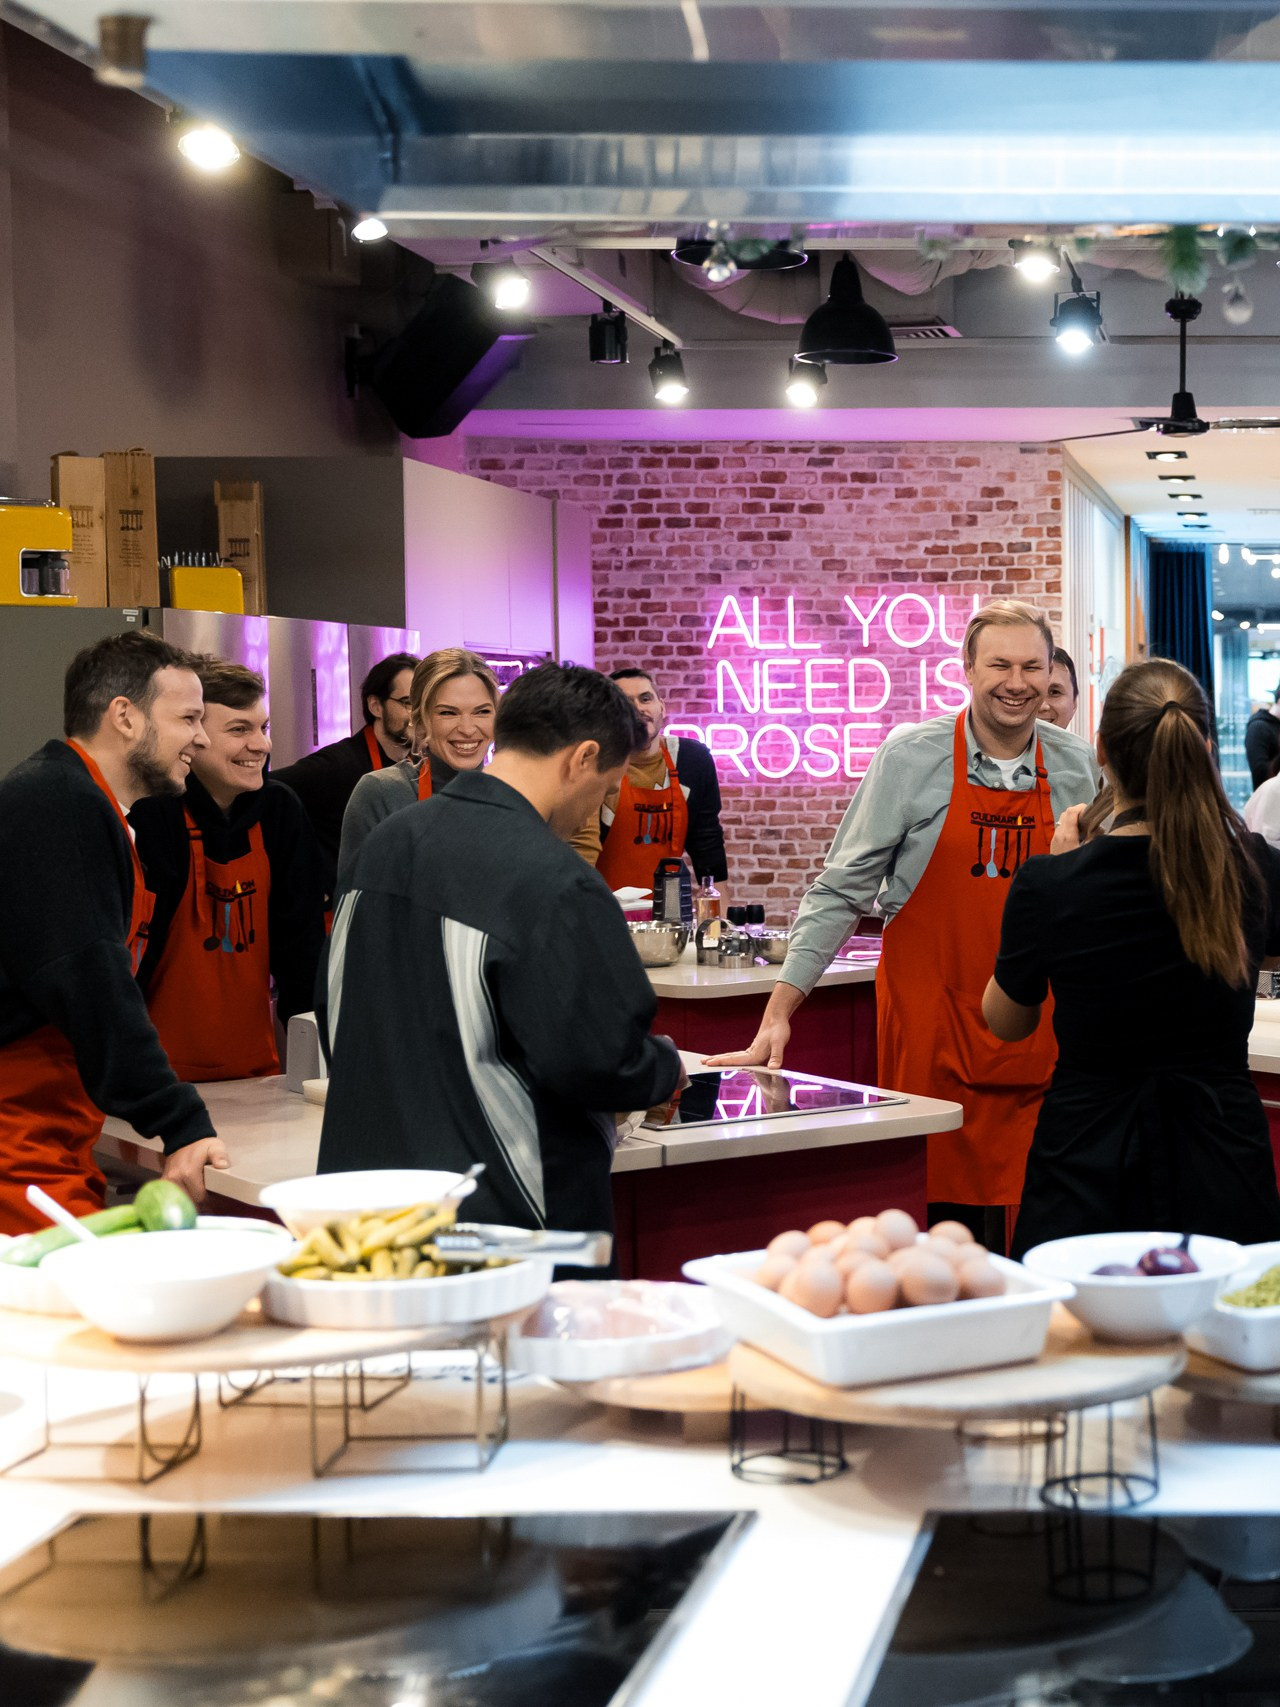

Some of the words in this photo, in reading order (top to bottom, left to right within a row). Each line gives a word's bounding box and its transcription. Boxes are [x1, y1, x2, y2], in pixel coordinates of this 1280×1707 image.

[707, 594, 821, 649] ALL
[844, 593, 980, 648] YOU
[716, 658, 891, 714] NEED
[920, 658, 971, 712] IS
[663, 723, 916, 778] ROSE
